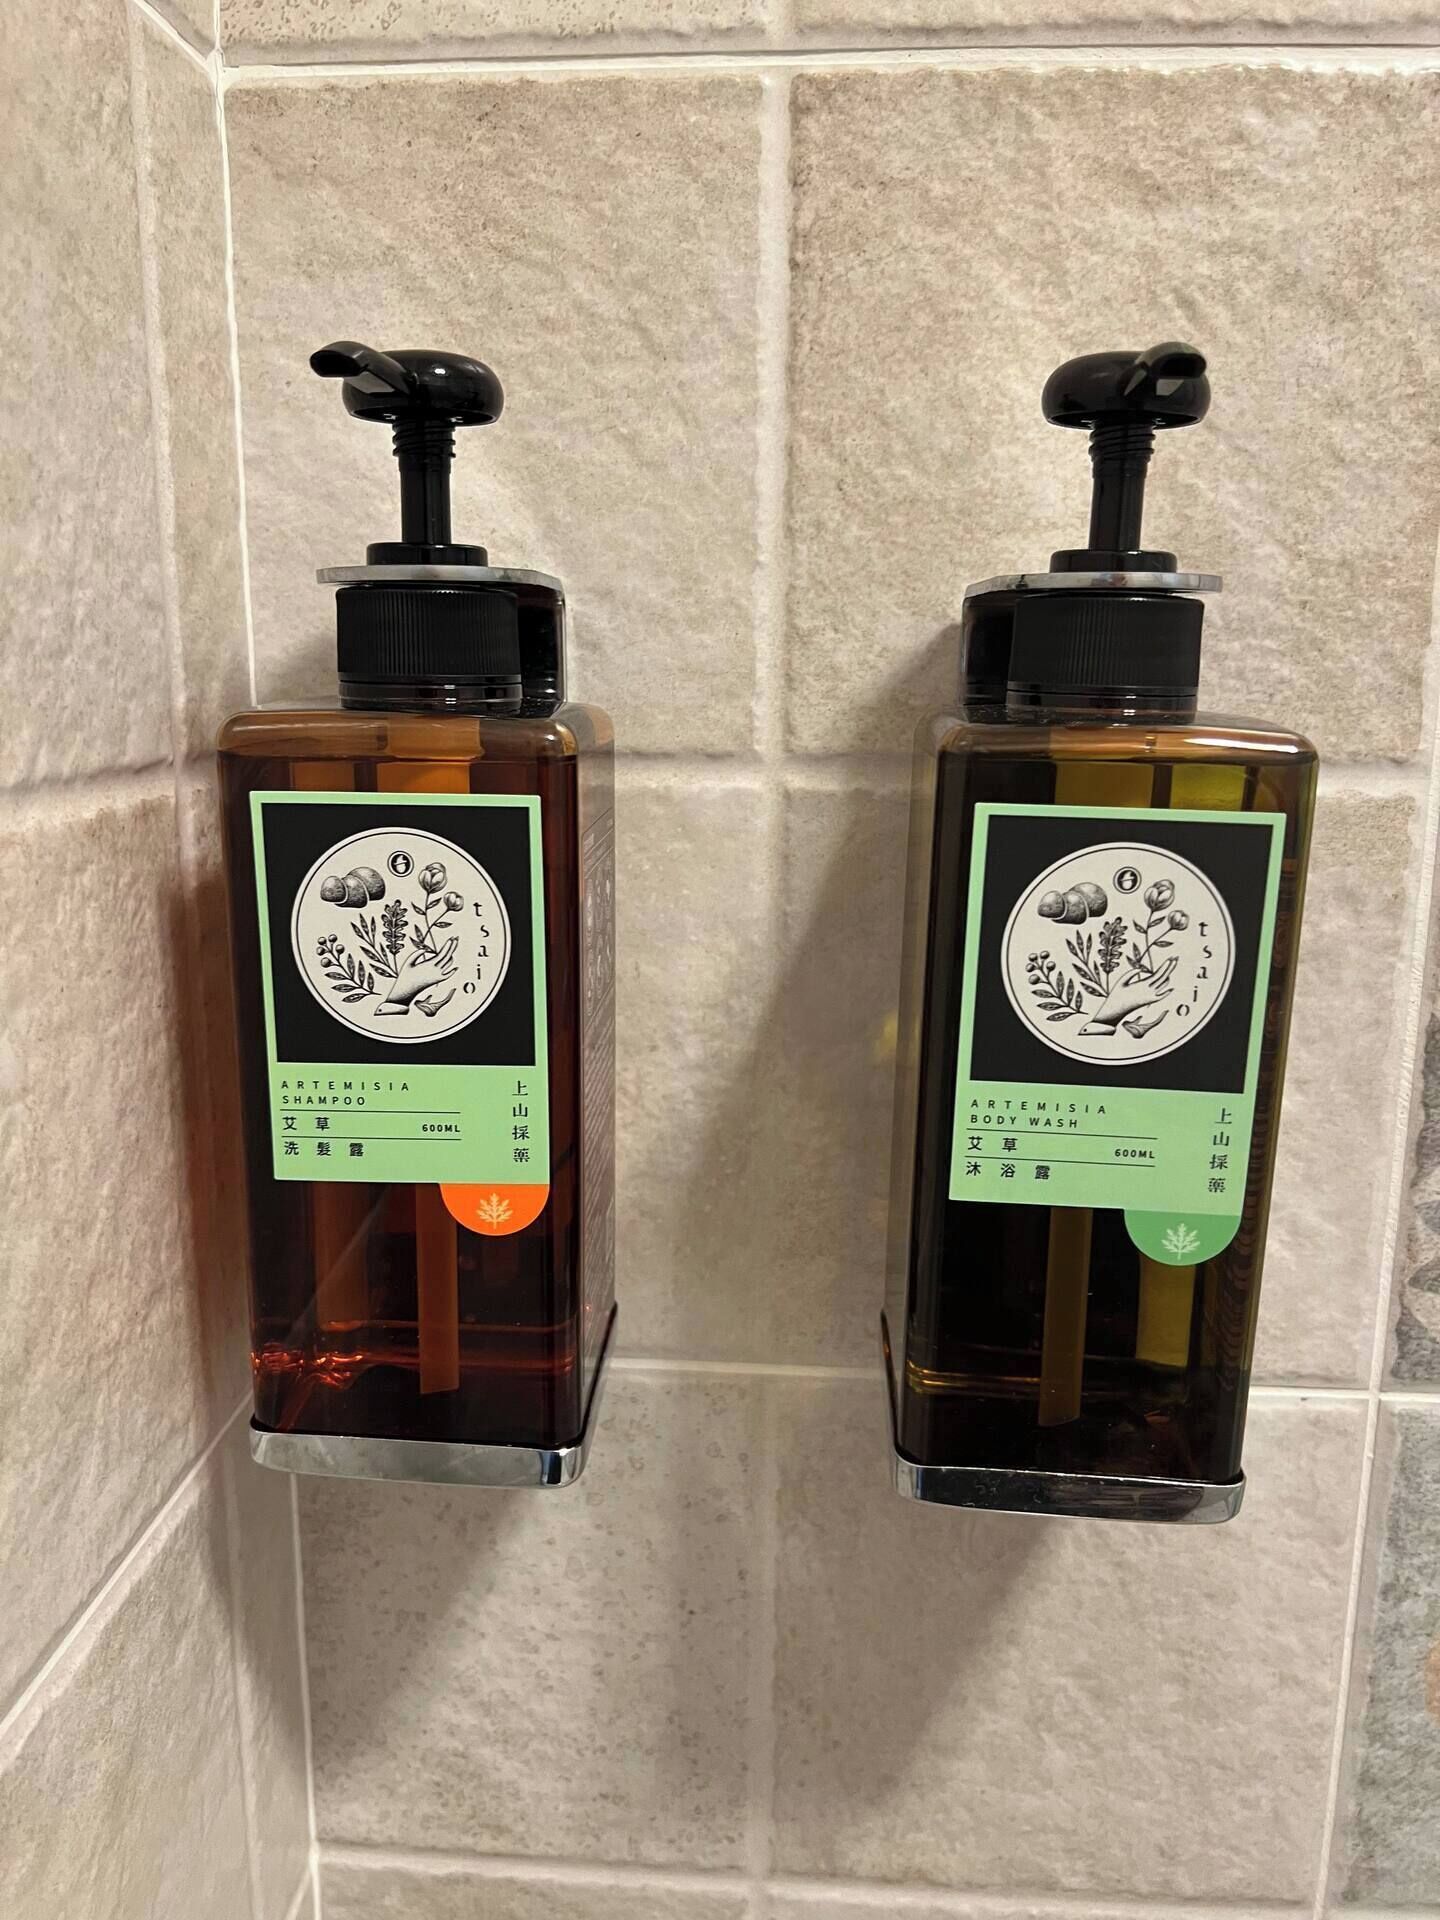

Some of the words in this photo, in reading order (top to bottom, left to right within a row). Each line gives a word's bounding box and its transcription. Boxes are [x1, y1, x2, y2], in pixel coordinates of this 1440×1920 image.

[463, 900, 490, 996] tsaio
[1176, 920, 1211, 1018] tsaio
[281, 1080, 410, 1092] ARTEMISIA
[282, 1095, 366, 1106] SHAMPOO
[970, 1098, 1107, 1115] ARTEMISIA
[282, 1116, 331, 1131] 艾草
[422, 1124, 461, 1133] 600ML
[970, 1114, 1017, 1126] BODY
[1029, 1116, 1079, 1129] WASH
[283, 1141, 365, 1157] 洗髮露
[966, 1135, 1018, 1152] 艾草
[1114, 1148, 1156, 1159] 600ML
[965, 1160, 1051, 1180] 沐浴露
